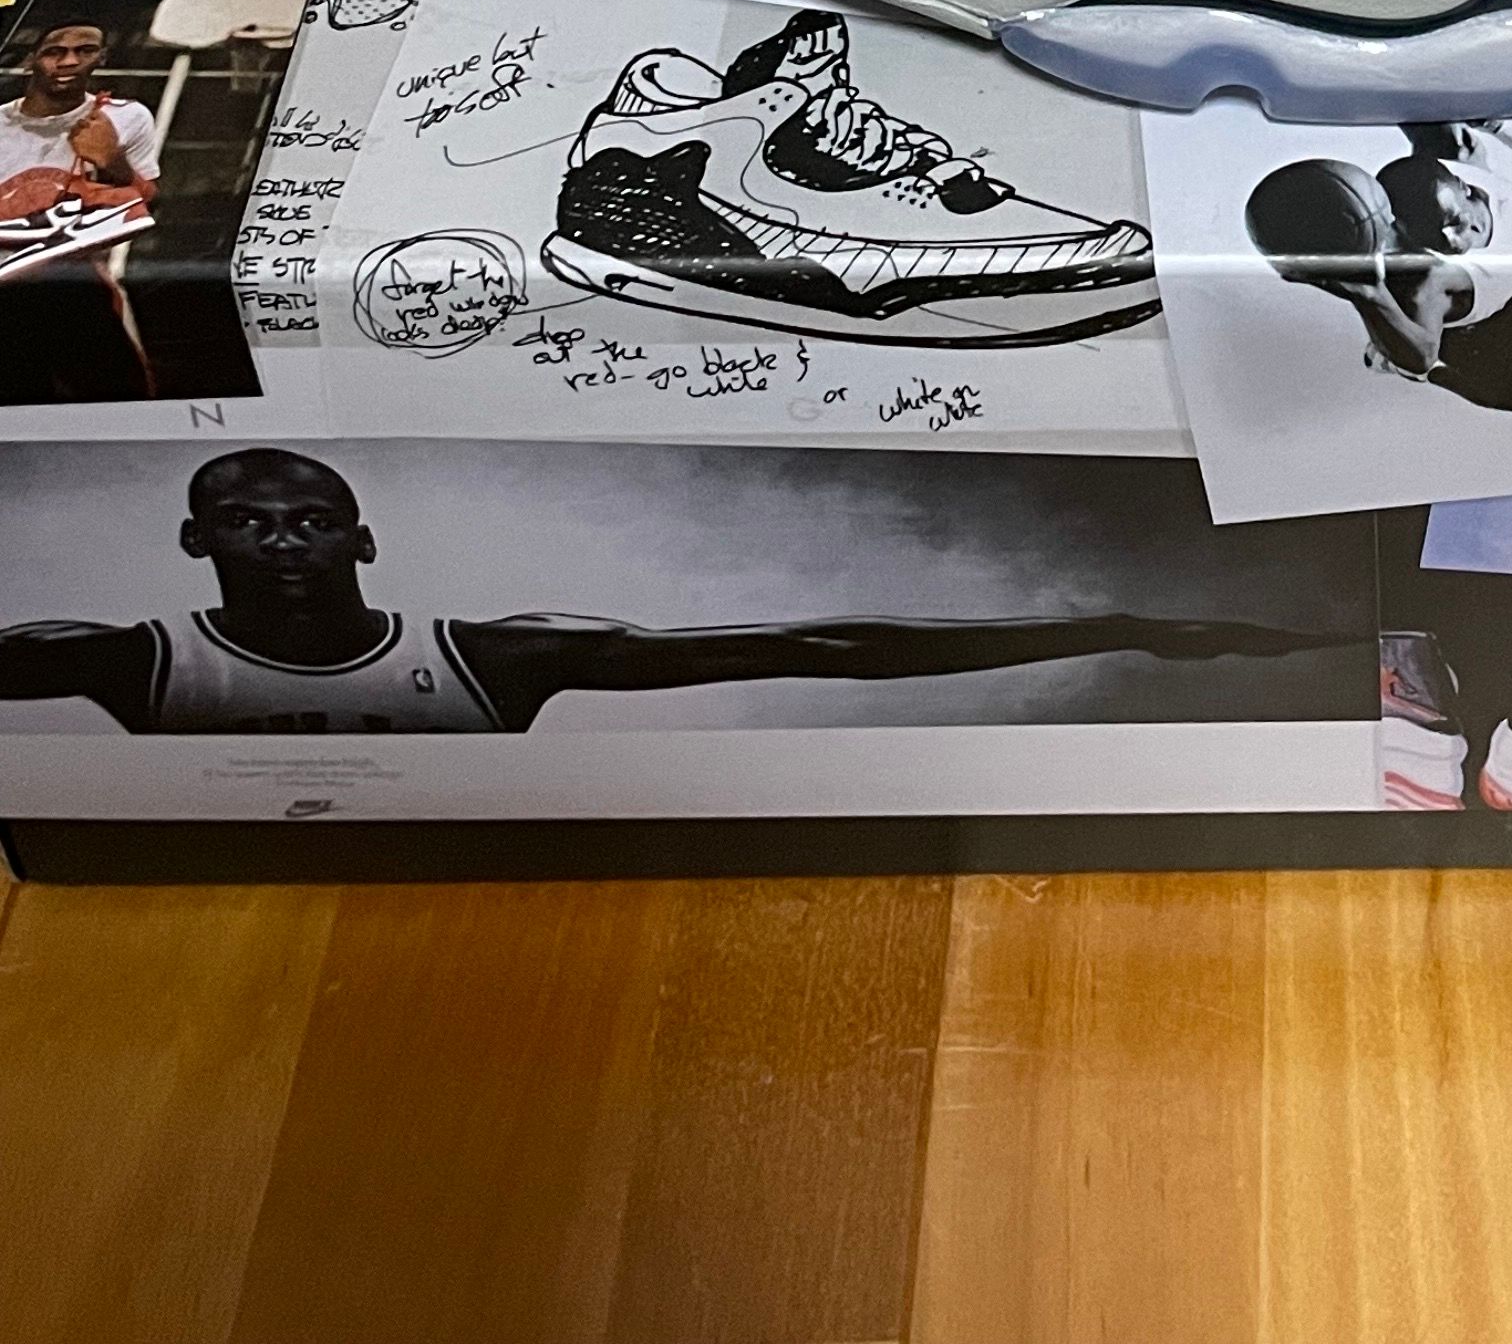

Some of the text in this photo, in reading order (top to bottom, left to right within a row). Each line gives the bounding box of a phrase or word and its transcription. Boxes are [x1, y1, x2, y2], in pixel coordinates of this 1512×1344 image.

[279, 229, 317, 247] OF
[647, 364, 688, 390] go
[701, 345, 778, 376] black
[687, 374, 769, 398] white
[823, 386, 849, 405] or
[879, 376, 943, 423] white
